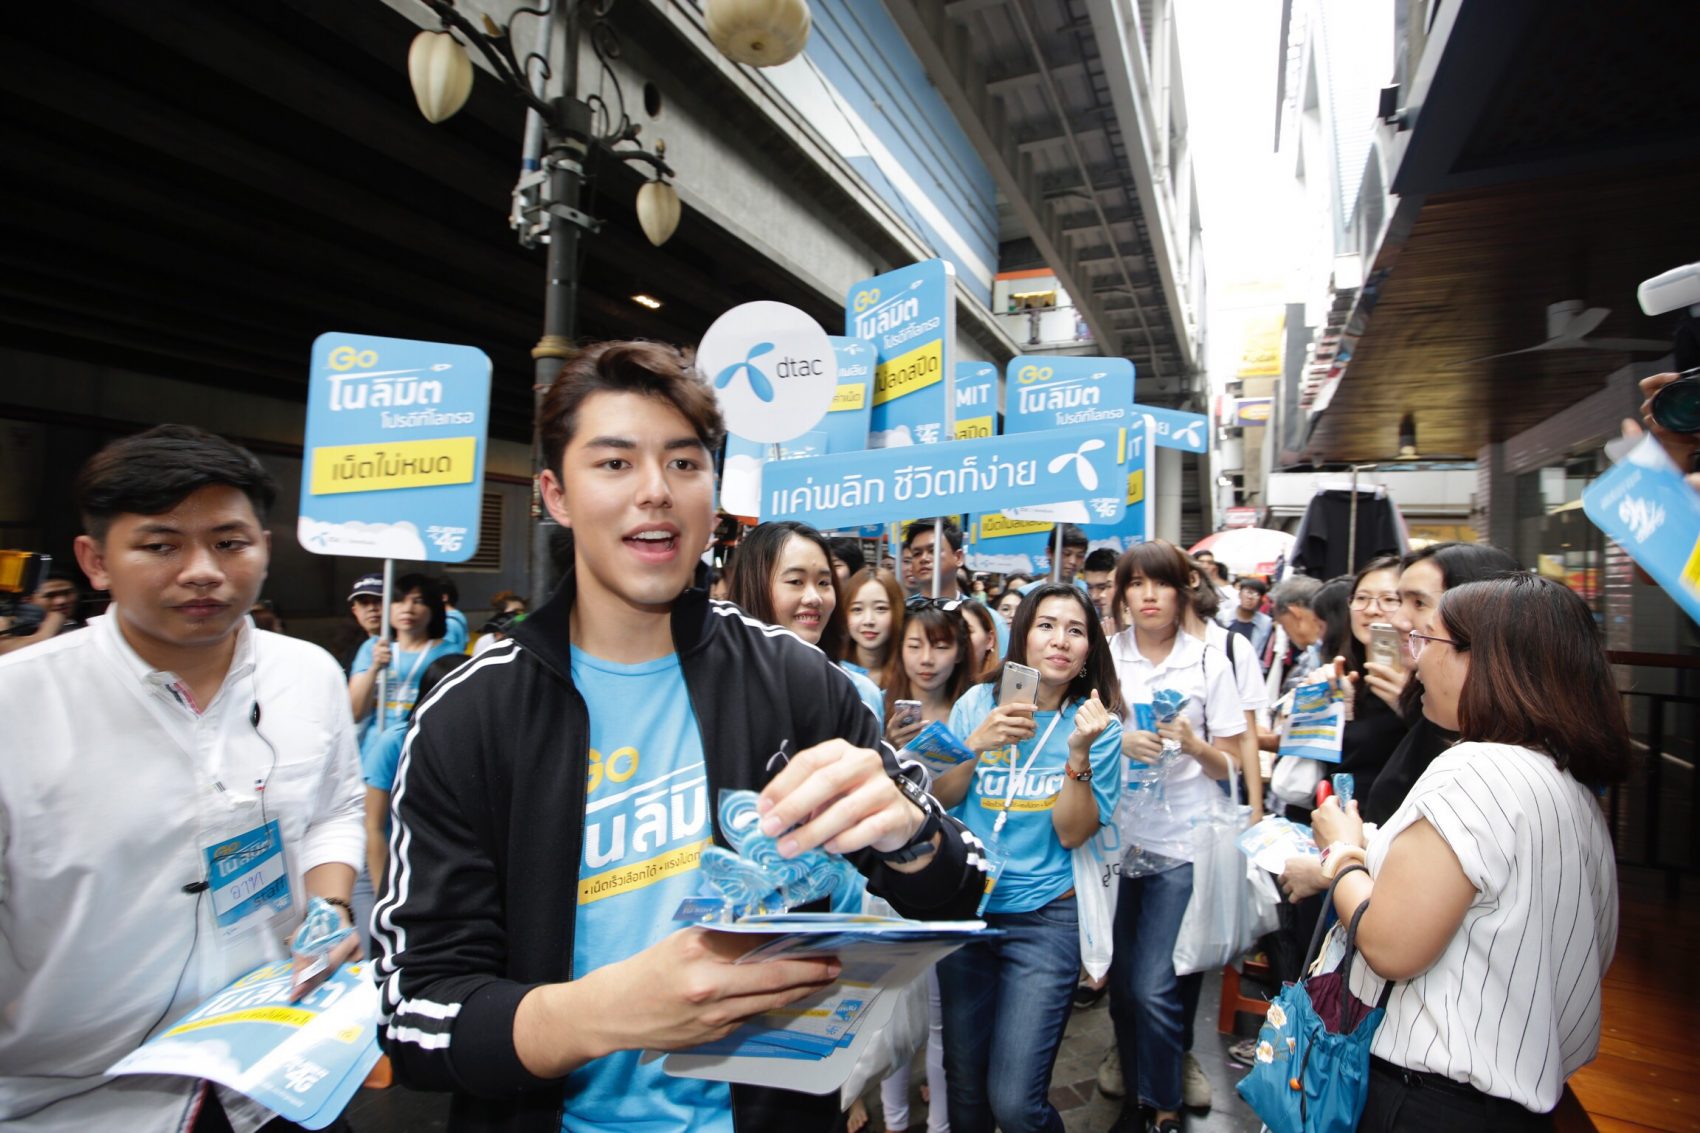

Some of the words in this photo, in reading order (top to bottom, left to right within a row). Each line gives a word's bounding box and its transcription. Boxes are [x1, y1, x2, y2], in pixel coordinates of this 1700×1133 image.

[776, 356, 824, 379] dtac
[332, 451, 452, 481] เน็ตไม่หมด
[771, 474, 885, 516] แค่พลิก
[894, 455, 1037, 501] ชีวิตก็ง่าย
